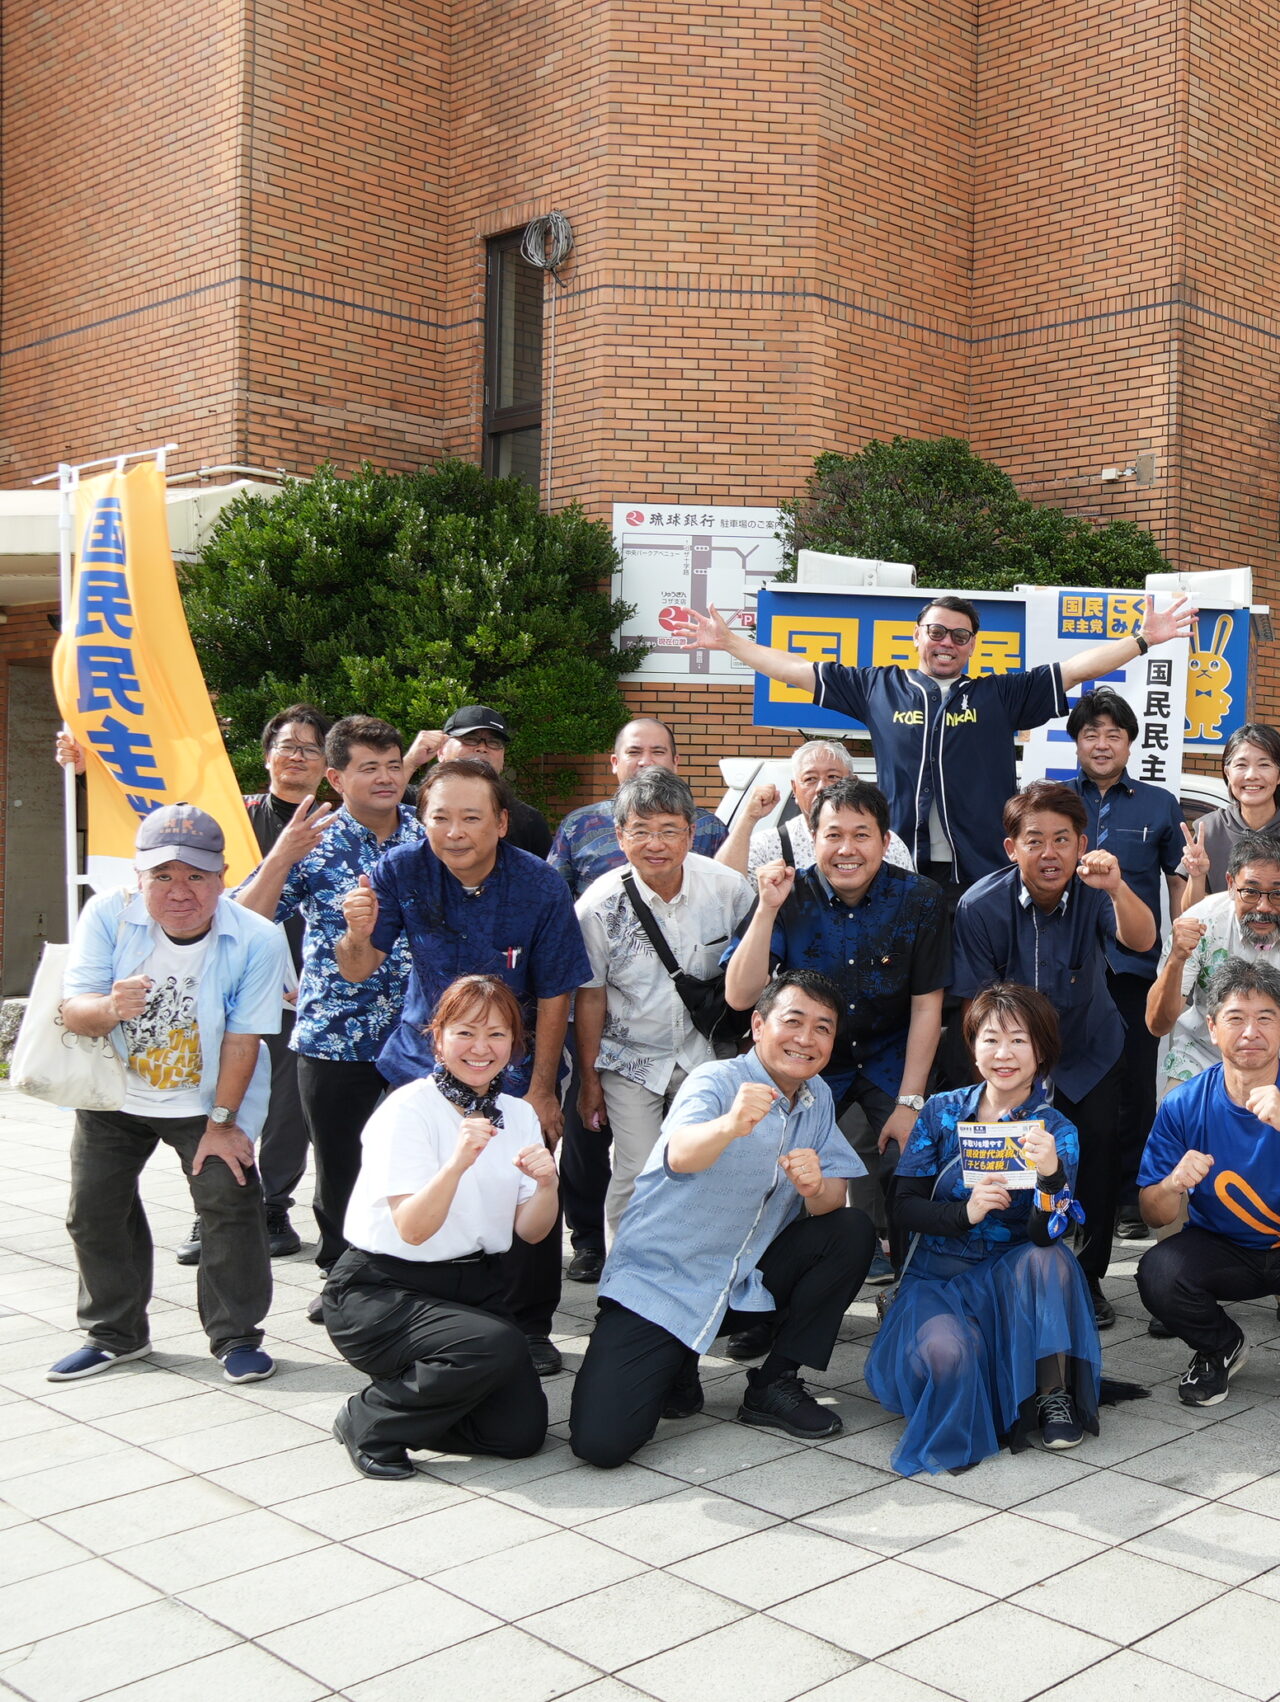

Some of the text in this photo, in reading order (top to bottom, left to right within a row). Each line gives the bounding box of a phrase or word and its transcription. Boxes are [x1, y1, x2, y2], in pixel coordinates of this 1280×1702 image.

[649, 512, 784, 529] 琉球銀行 駐車場のご案内
[1062, 597, 1146, 617] 国民 こく
[743, 615, 753, 626] P
[1062, 619, 1104, 633] 民主党
[892, 710, 925, 726] KOE
[1140, 659, 1172, 782] 国民民主
